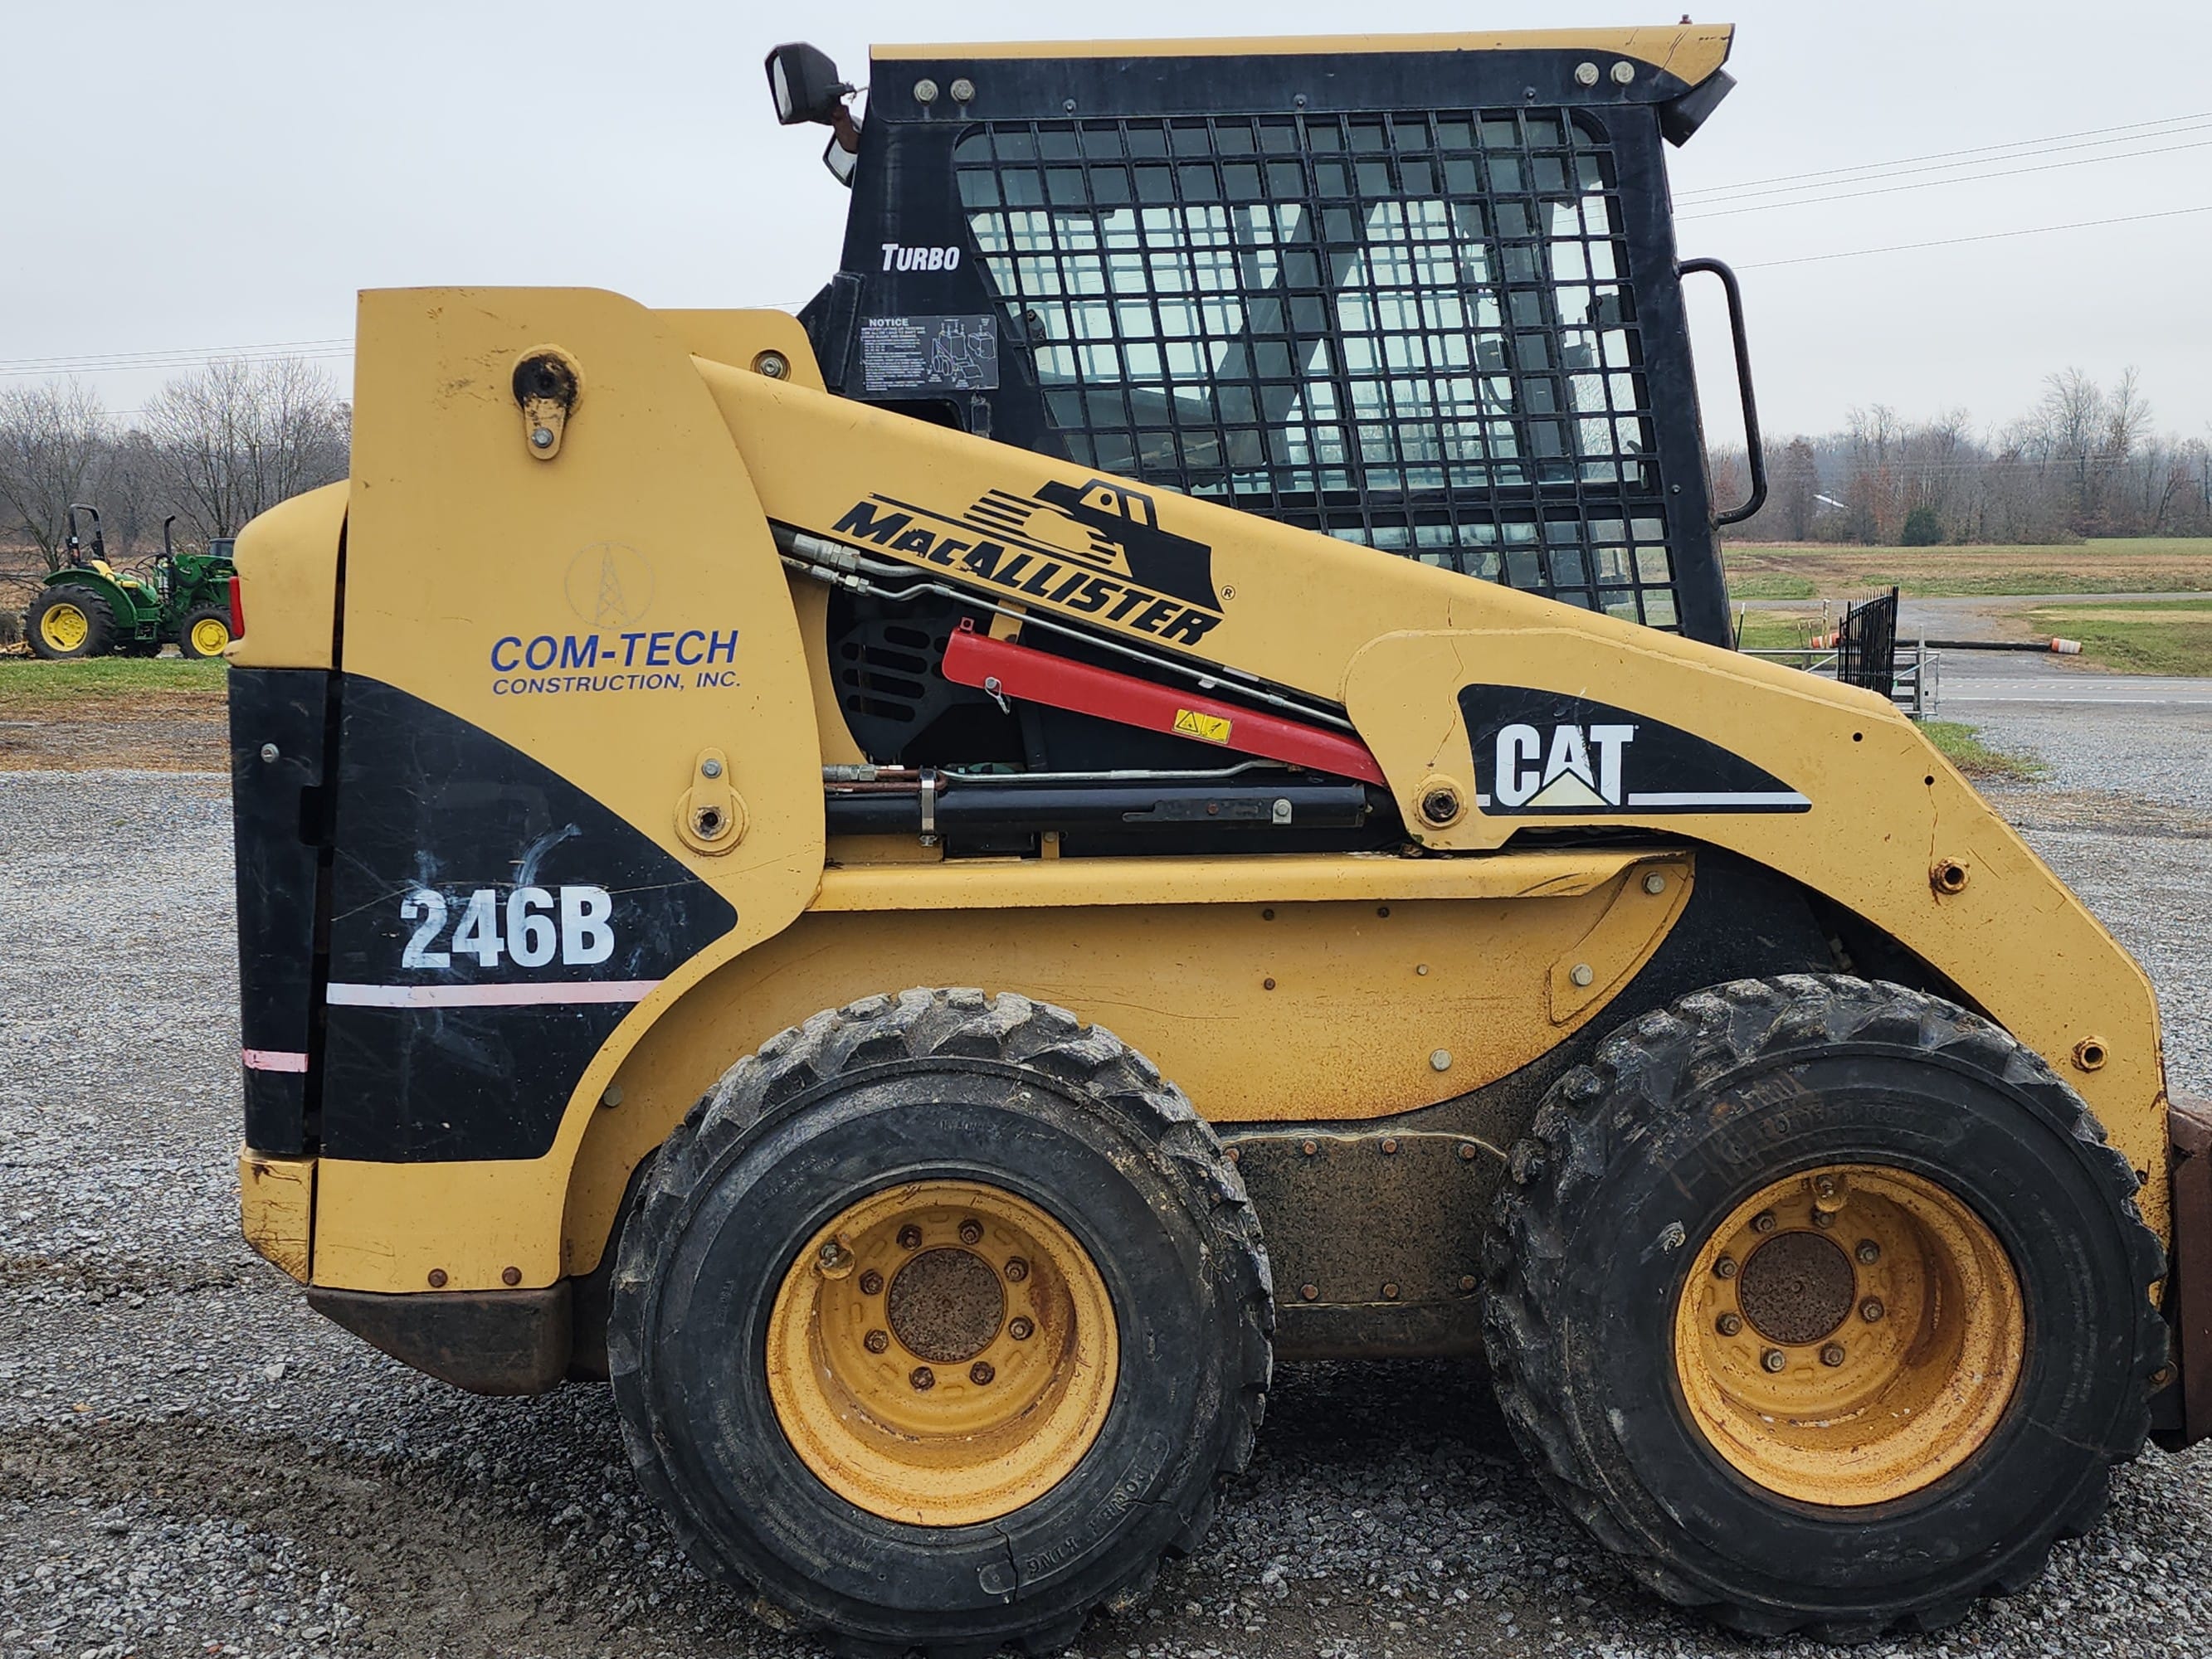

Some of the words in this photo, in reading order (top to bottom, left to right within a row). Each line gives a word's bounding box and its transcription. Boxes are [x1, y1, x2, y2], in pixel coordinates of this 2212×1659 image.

[882, 243, 960, 271] TURBO
[870, 318, 909, 327] NOTICE
[490, 630, 738, 672] COM-TECH
[493, 674, 685, 695] CONSTRUCTION,
[696, 670, 741, 688] INC.
[1496, 723, 1634, 806] CAT
[400, 886, 615, 969] 246B
